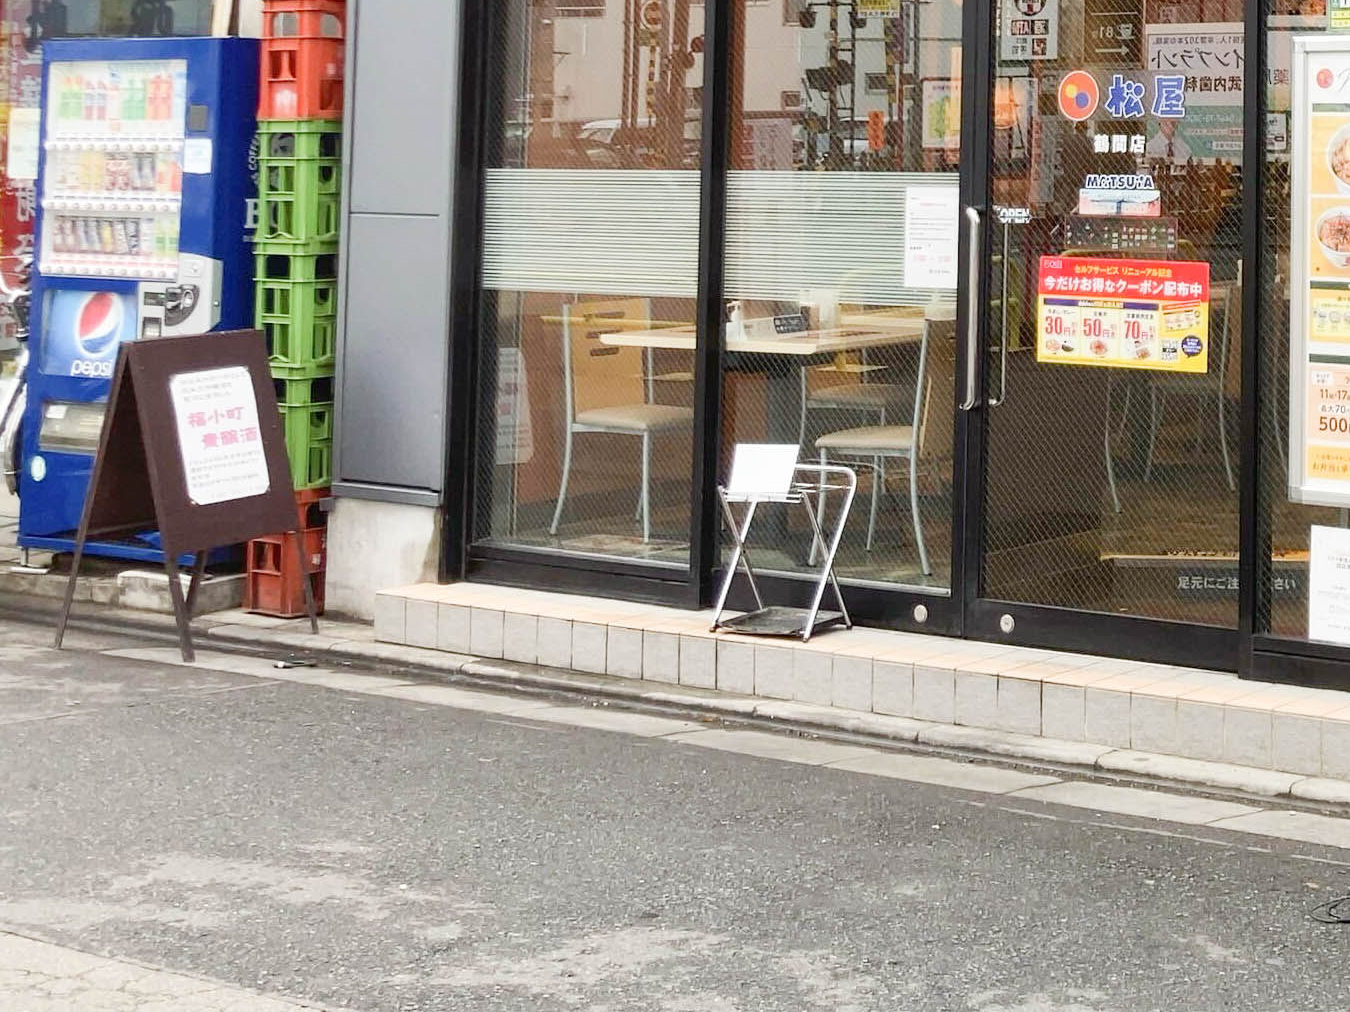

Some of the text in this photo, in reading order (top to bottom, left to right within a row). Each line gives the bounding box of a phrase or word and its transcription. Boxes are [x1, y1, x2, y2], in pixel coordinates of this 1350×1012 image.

[1104, 74, 1186, 119] 松屋
[1093, 134, 1146, 155] 鶴間店
[1043, 276, 1203, 298] 今だけお得なクーポン配布中
[71, 359, 115, 377] pepsi
